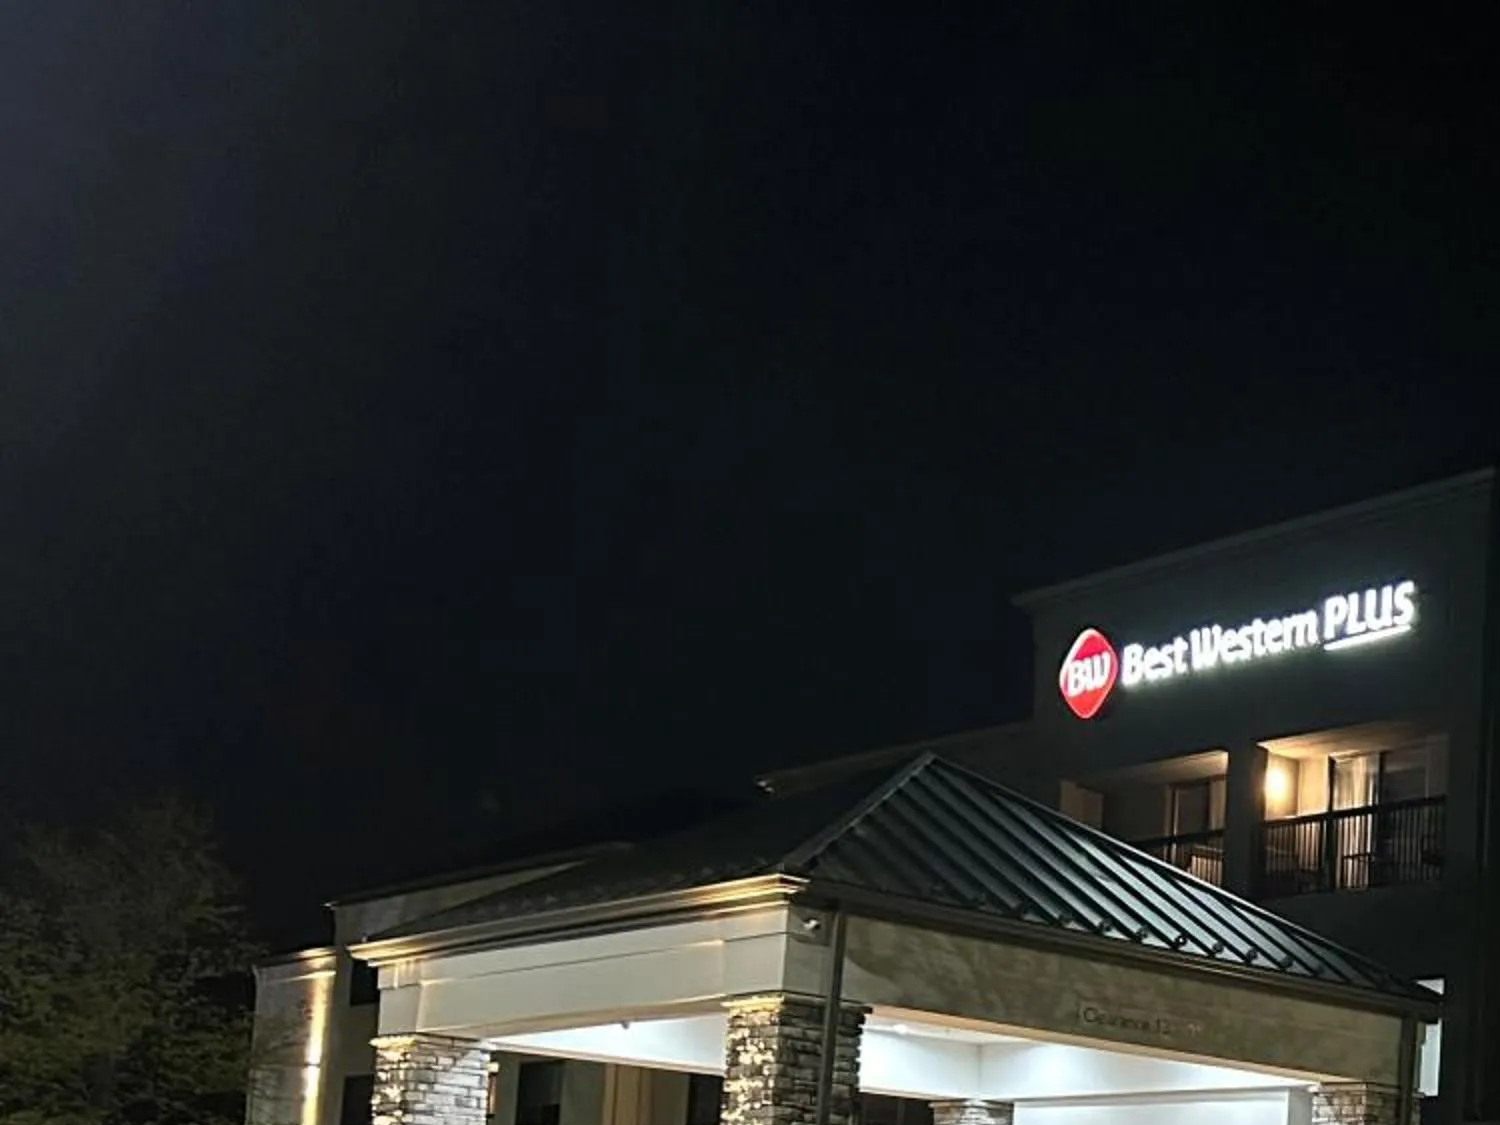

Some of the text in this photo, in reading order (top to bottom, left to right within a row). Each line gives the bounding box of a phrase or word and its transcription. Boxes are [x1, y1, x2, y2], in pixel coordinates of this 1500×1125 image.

[1121, 580, 1415, 686] Best Western PLUS
[1067, 651, 1110, 697] BW
